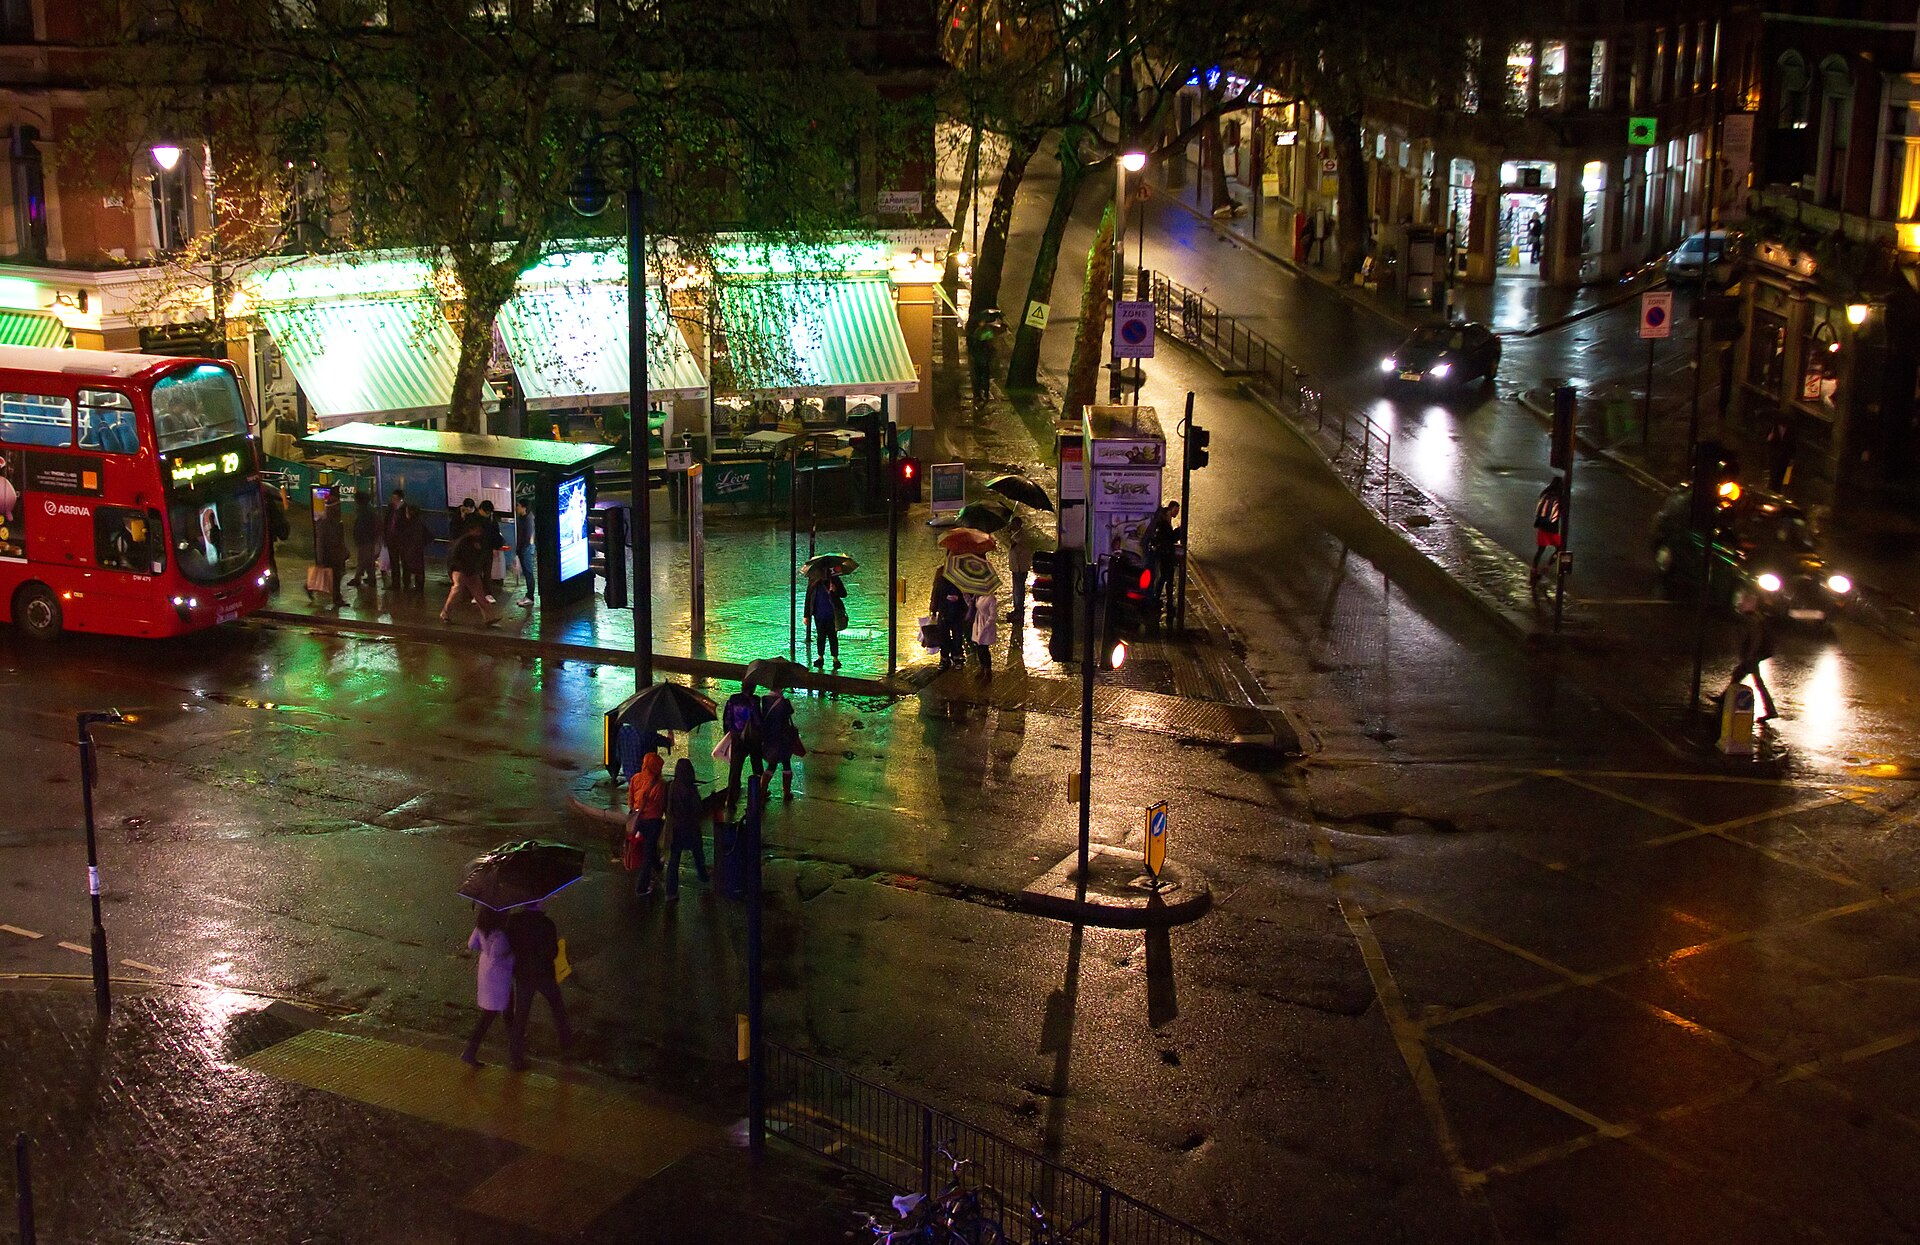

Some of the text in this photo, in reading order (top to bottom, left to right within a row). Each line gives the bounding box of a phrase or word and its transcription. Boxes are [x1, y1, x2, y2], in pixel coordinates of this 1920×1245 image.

[1122, 310, 1147, 318] ZONE
[222, 452, 239, 474] 29
[515, 481, 536, 494] Léo
[58, 504, 91, 517] ARRIVA
